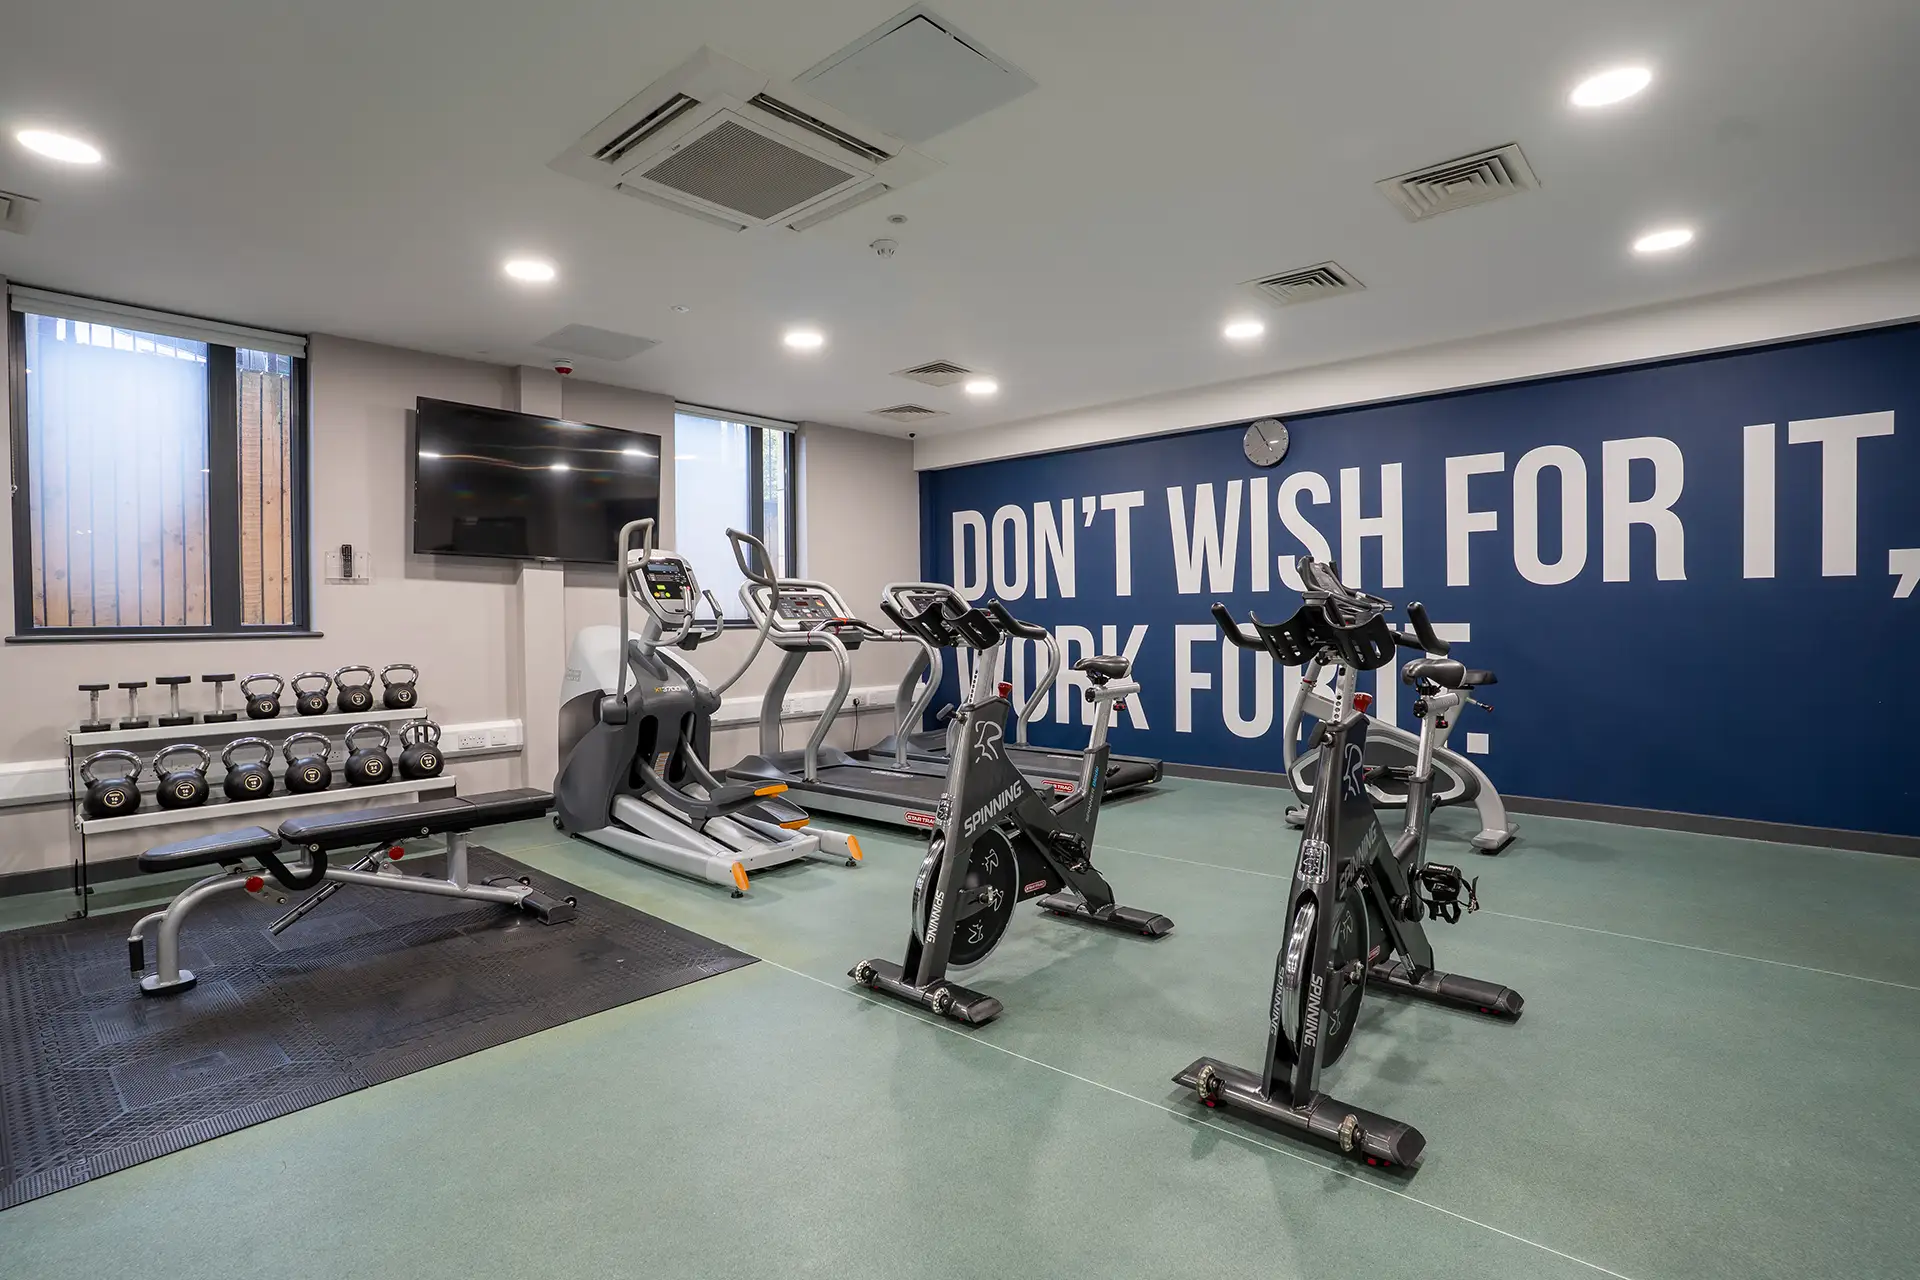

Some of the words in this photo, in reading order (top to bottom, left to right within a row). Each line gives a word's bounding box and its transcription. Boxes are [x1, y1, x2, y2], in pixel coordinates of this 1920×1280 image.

[953, 490, 1145, 601] DON'T
[1166, 463, 1404, 595] WISH
[1445, 436, 1687, 587] FOR
[1743, 410, 1920, 598] IT,
[964, 779, 1022, 838] SPINNING
[1339, 820, 1377, 890] SPINNING
[926, 890, 945, 943] SPINNING
[1270, 964, 1285, 1036] SPINNING
[1304, 973, 1324, 1048] SPINNING
